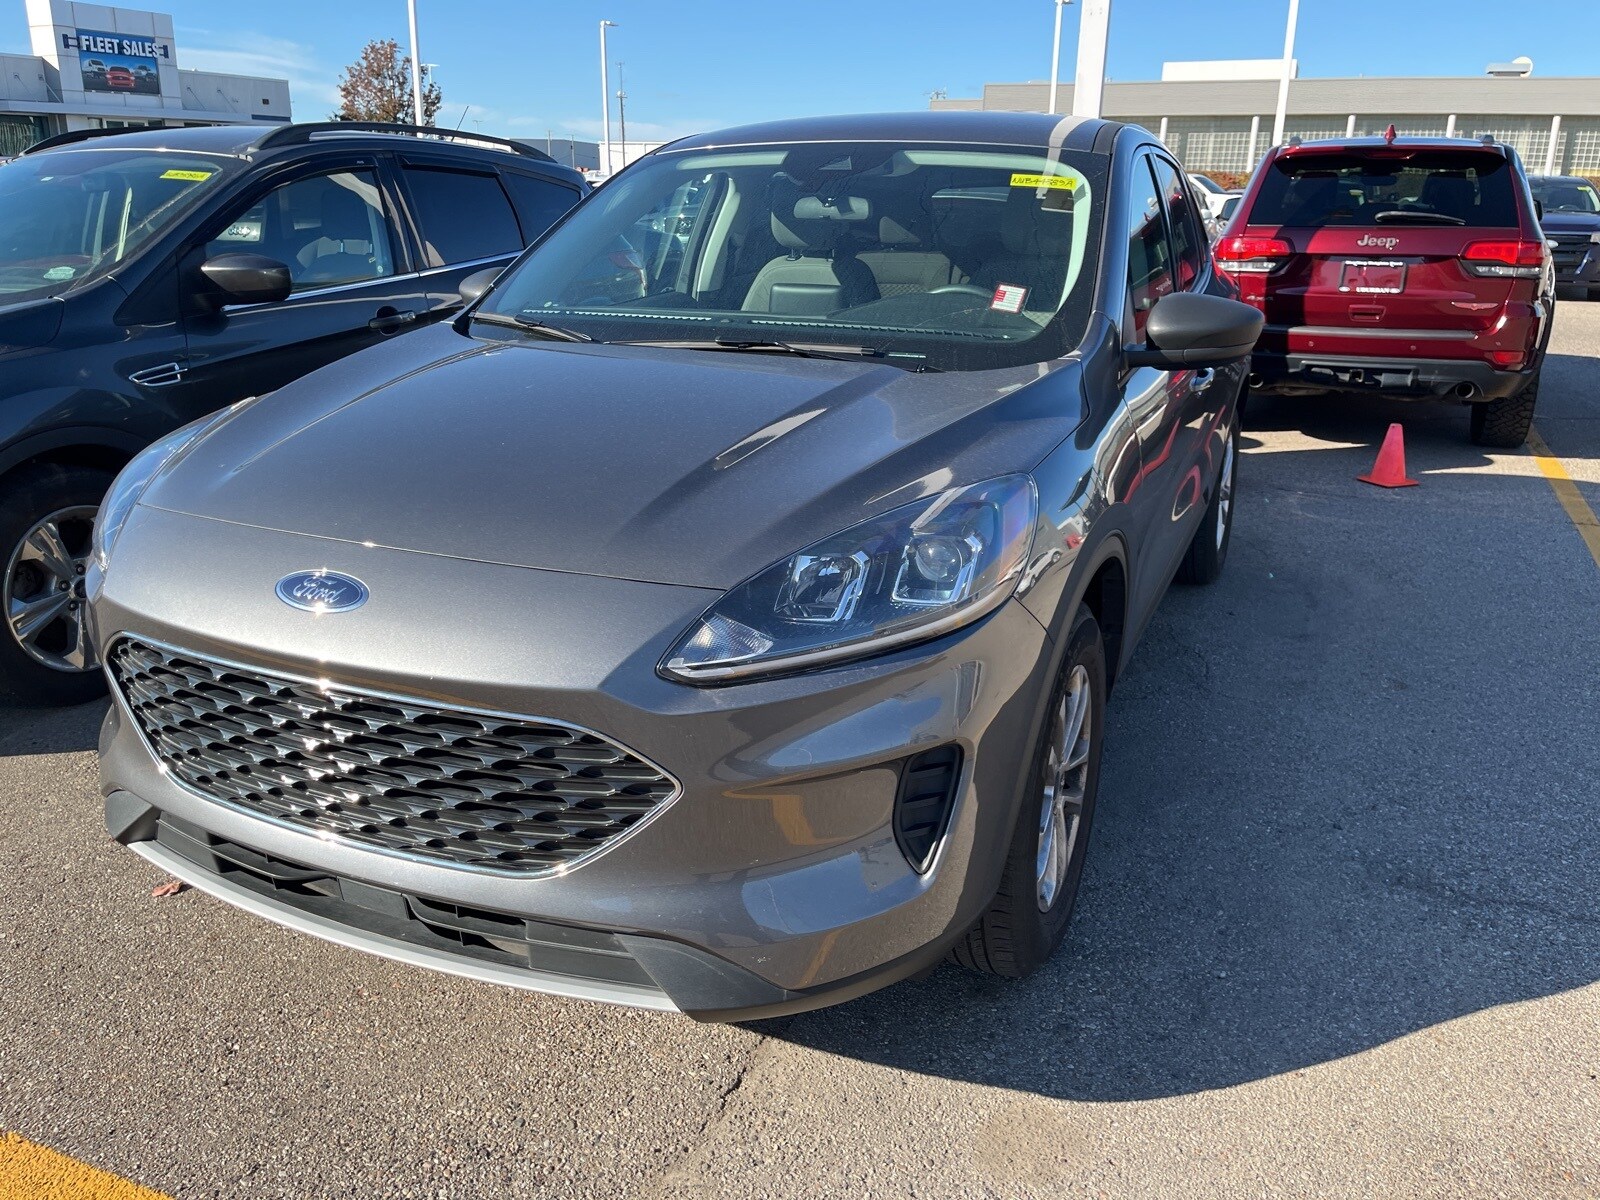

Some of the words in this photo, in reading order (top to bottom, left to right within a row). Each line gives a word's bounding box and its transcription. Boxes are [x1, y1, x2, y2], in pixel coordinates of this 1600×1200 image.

[80, 35, 120, 54] FLEET
[122, 39, 160, 58] SALES
[1357, 234, 1397, 249] Jeep
[293, 577, 347, 603] Ford
